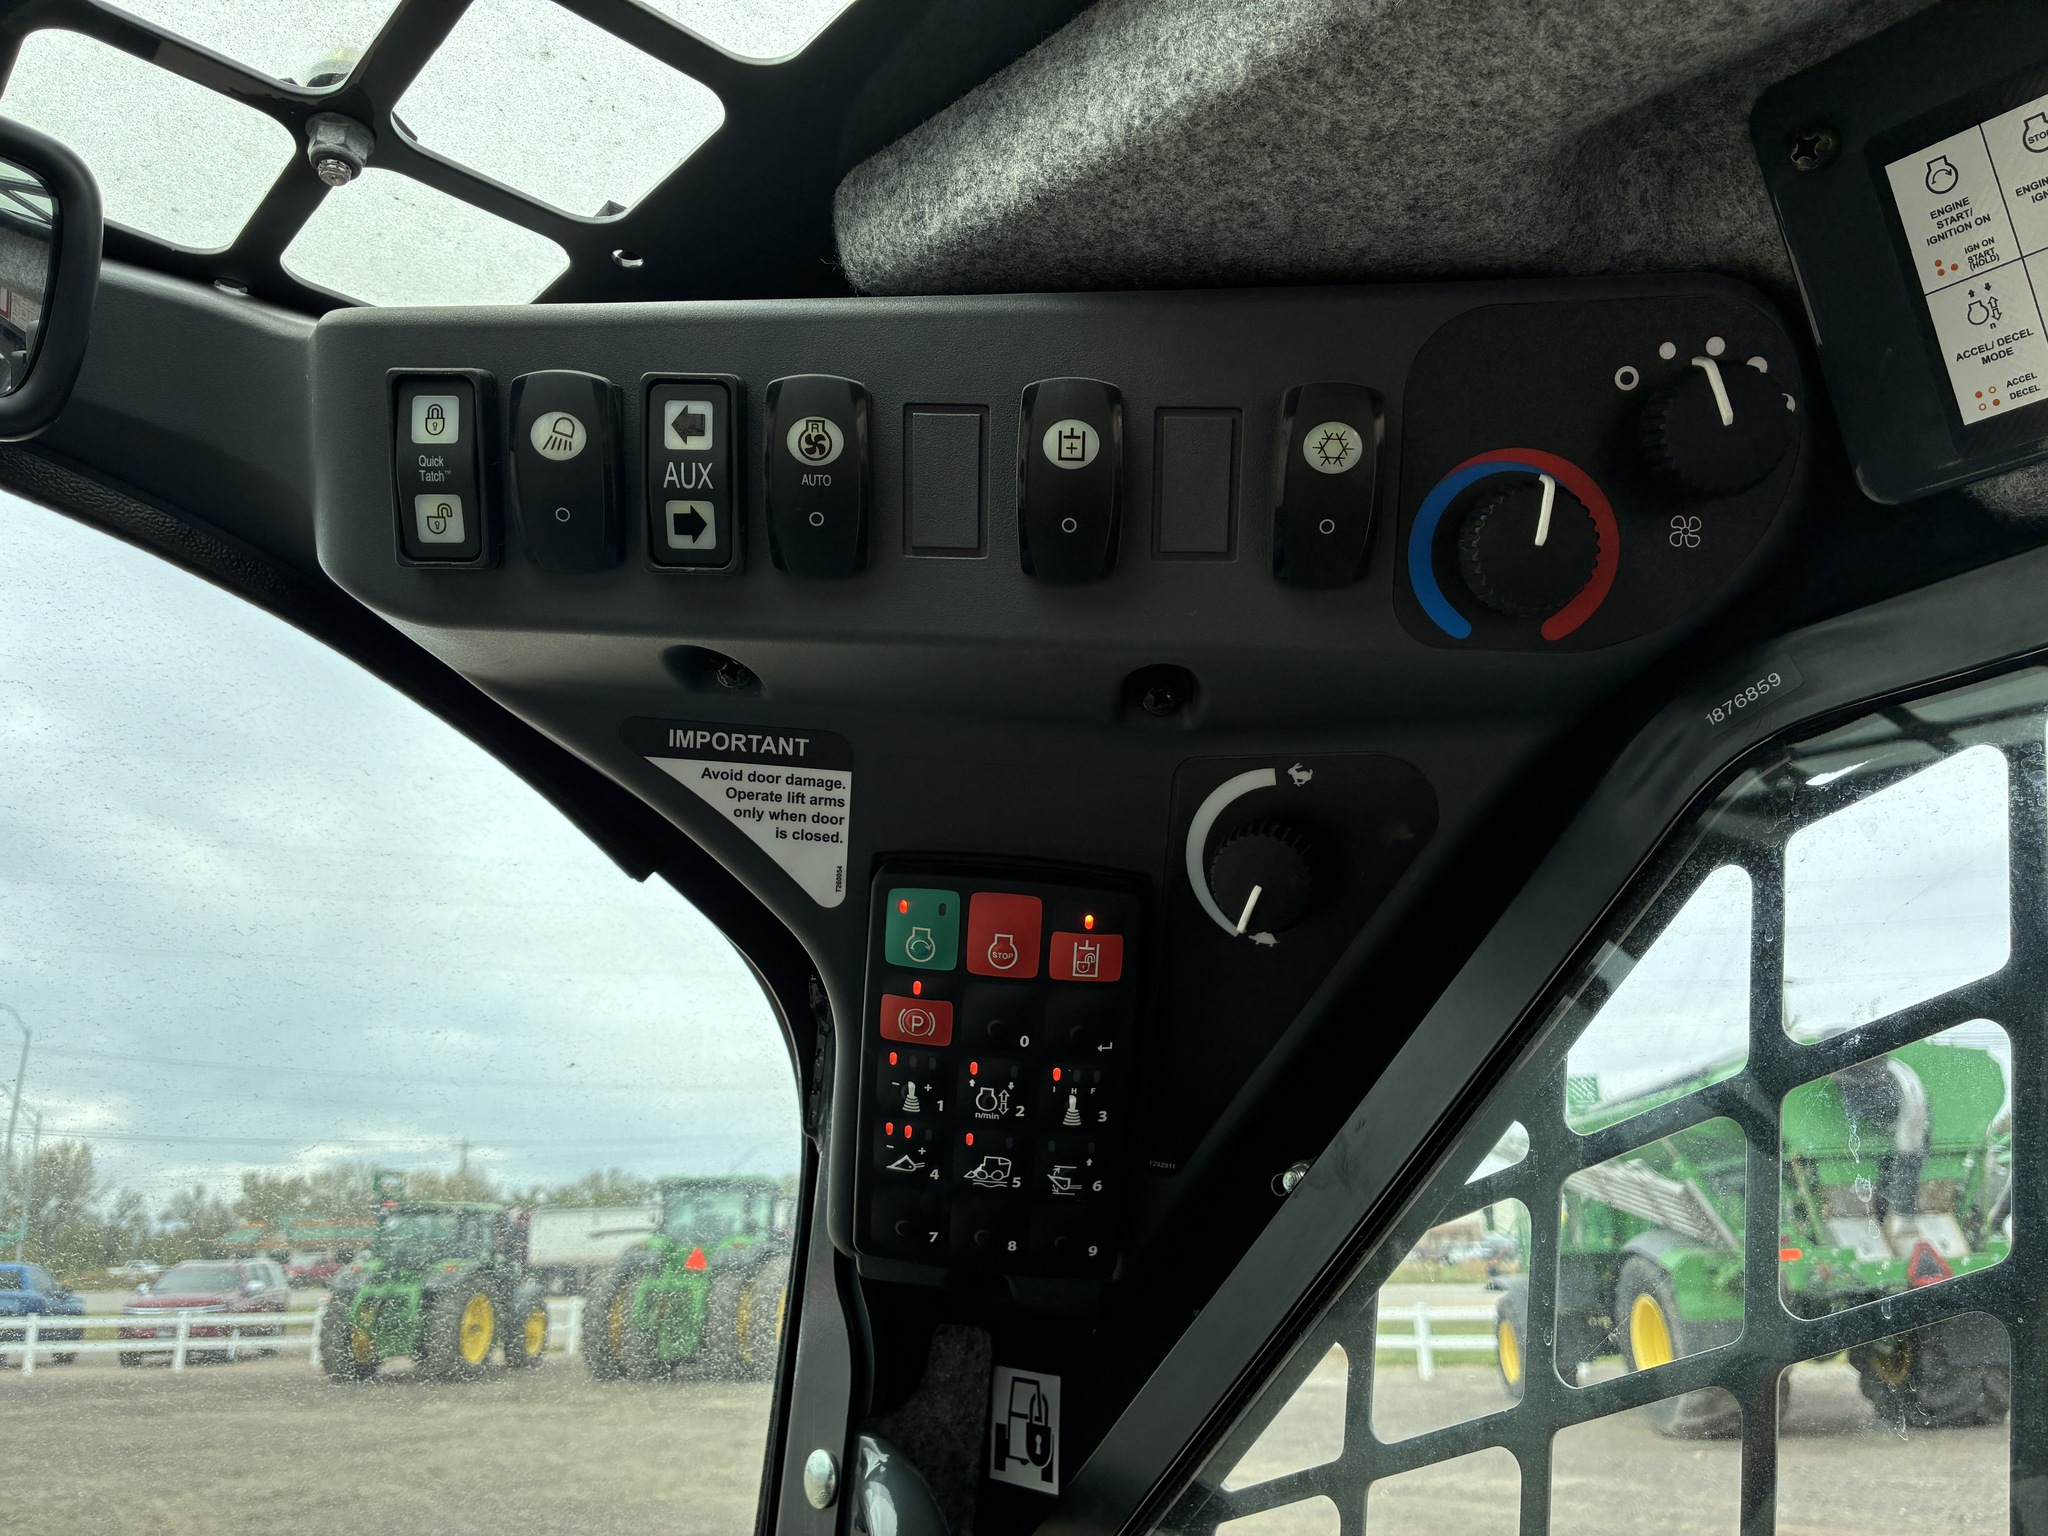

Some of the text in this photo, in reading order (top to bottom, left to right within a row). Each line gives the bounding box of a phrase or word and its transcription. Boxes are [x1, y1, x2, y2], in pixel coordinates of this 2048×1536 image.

[2027, 129, 2048, 144] STO
[2015, 176, 2048, 197] ENGIN
[1929, 196, 1971, 220] ENGINE
[1936, 207, 1973, 229] START/
[1926, 214, 1991, 246] IGNITION ON
[1964, 236, 1995, 254] IGN ON
[1967, 247, 1995, 264] START
[1969, 253, 2000, 271] (HOLD)
[1956, 328, 2034, 362] ACCEL/ DECEL
[1981, 346, 2014, 365] MODE
[2006, 372, 2038, 388] ACCEL
[2009, 384, 2041, 400] DECEL
[418, 454, 445, 468] Quick
[663, 461, 714, 490] AUX
[801, 474, 832, 487] AUTO
[1704, 672, 1781, 726] 1876859
[668, 728, 810, 757] IMPORTANT
[700, 767, 847, 791] Avoid door damage.
[725, 786, 846, 808] Operate lift arms
[733, 806, 845, 826] only when door
[775, 827, 844, 844] is closed.
[992, 951, 1014, 960] STOP
[911, 1015, 924, 1032] P
[1019, 1035, 1030, 1048] 0
[936, 1099, 944, 1112] 1
[1015, 1105, 1026, 1118] 2
[974, 1111, 1000, 1120] n/min
[1097, 1110, 1108, 1123] 3
[929, 1168, 940, 1181] 4
[1011, 1176, 1022, 1189] 5
[1092, 1180, 1103, 1192] 6
[928, 1231, 939, 1243] 7
[1007, 1240, 1018, 1252] 8
[1088, 1245, 1098, 1257] 9
